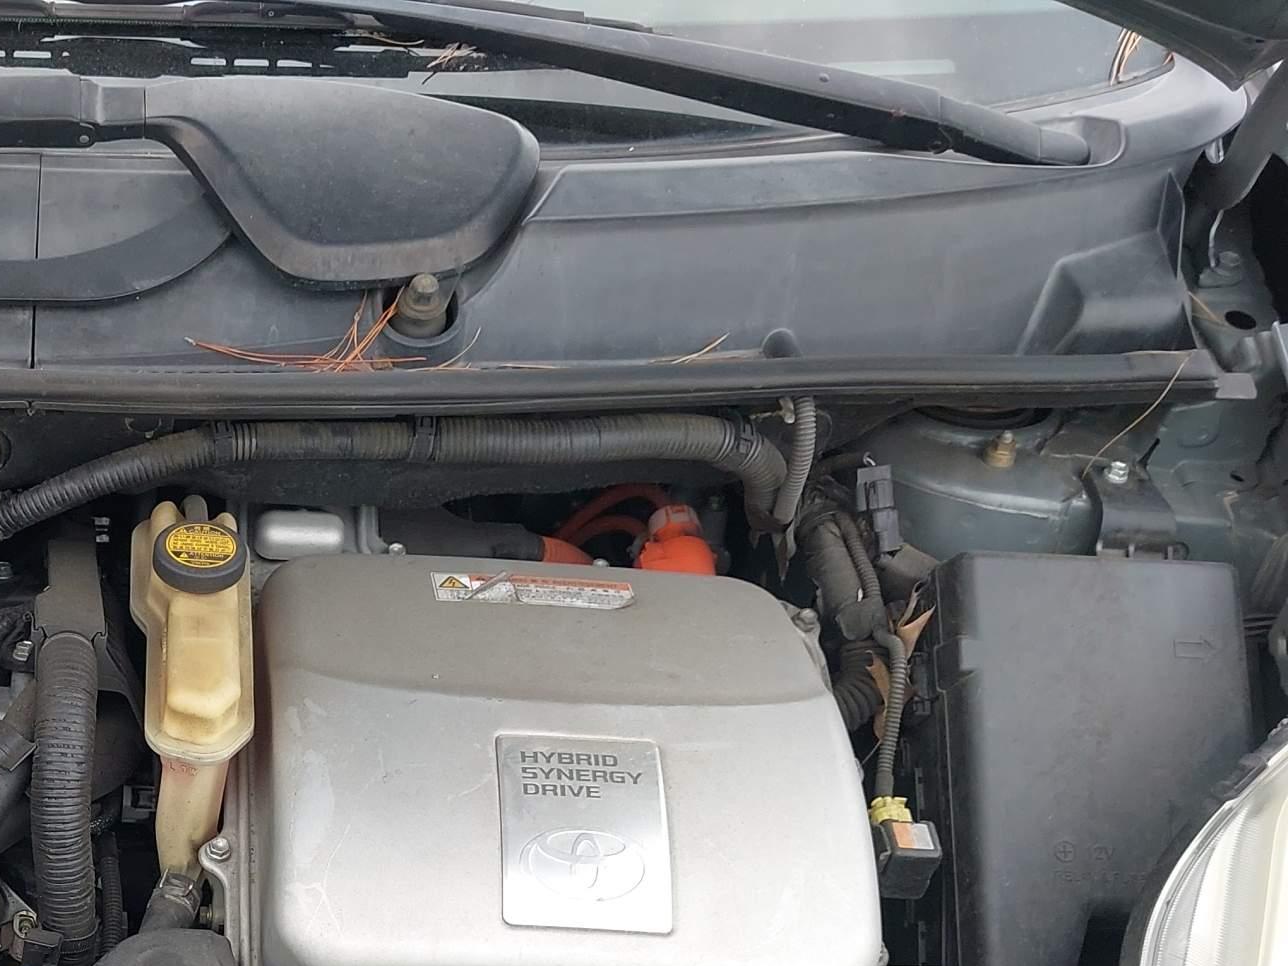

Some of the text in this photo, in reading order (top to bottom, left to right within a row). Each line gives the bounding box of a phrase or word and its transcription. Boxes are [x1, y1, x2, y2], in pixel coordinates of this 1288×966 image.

[519, 750, 619, 768] HYBRID
[521, 766, 643, 785] SYNERGY
[522, 783, 602, 799] DRIVE
